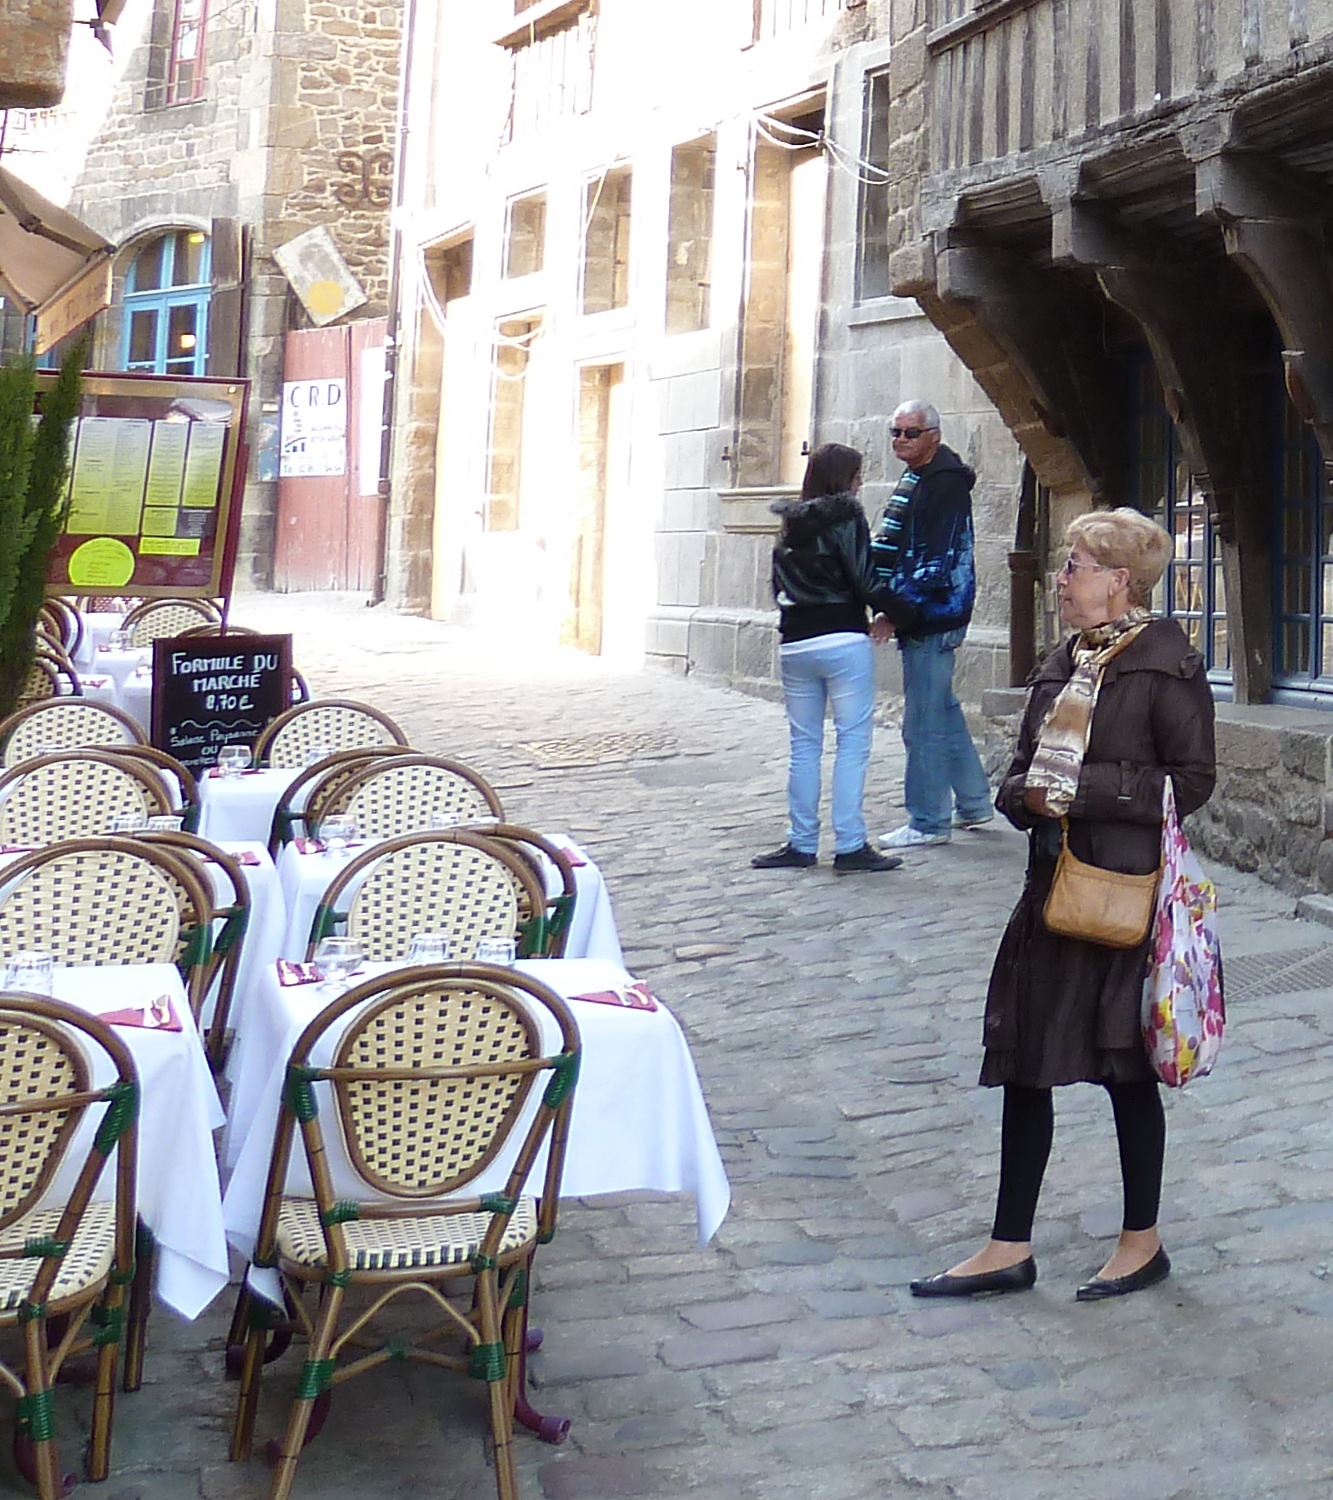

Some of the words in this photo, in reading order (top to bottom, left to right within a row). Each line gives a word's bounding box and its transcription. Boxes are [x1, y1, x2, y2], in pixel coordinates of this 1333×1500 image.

[172, 651, 244, 675] FORMULE
[253, 654, 278, 671] DU
[193, 669, 261, 693] MARCHÉ
